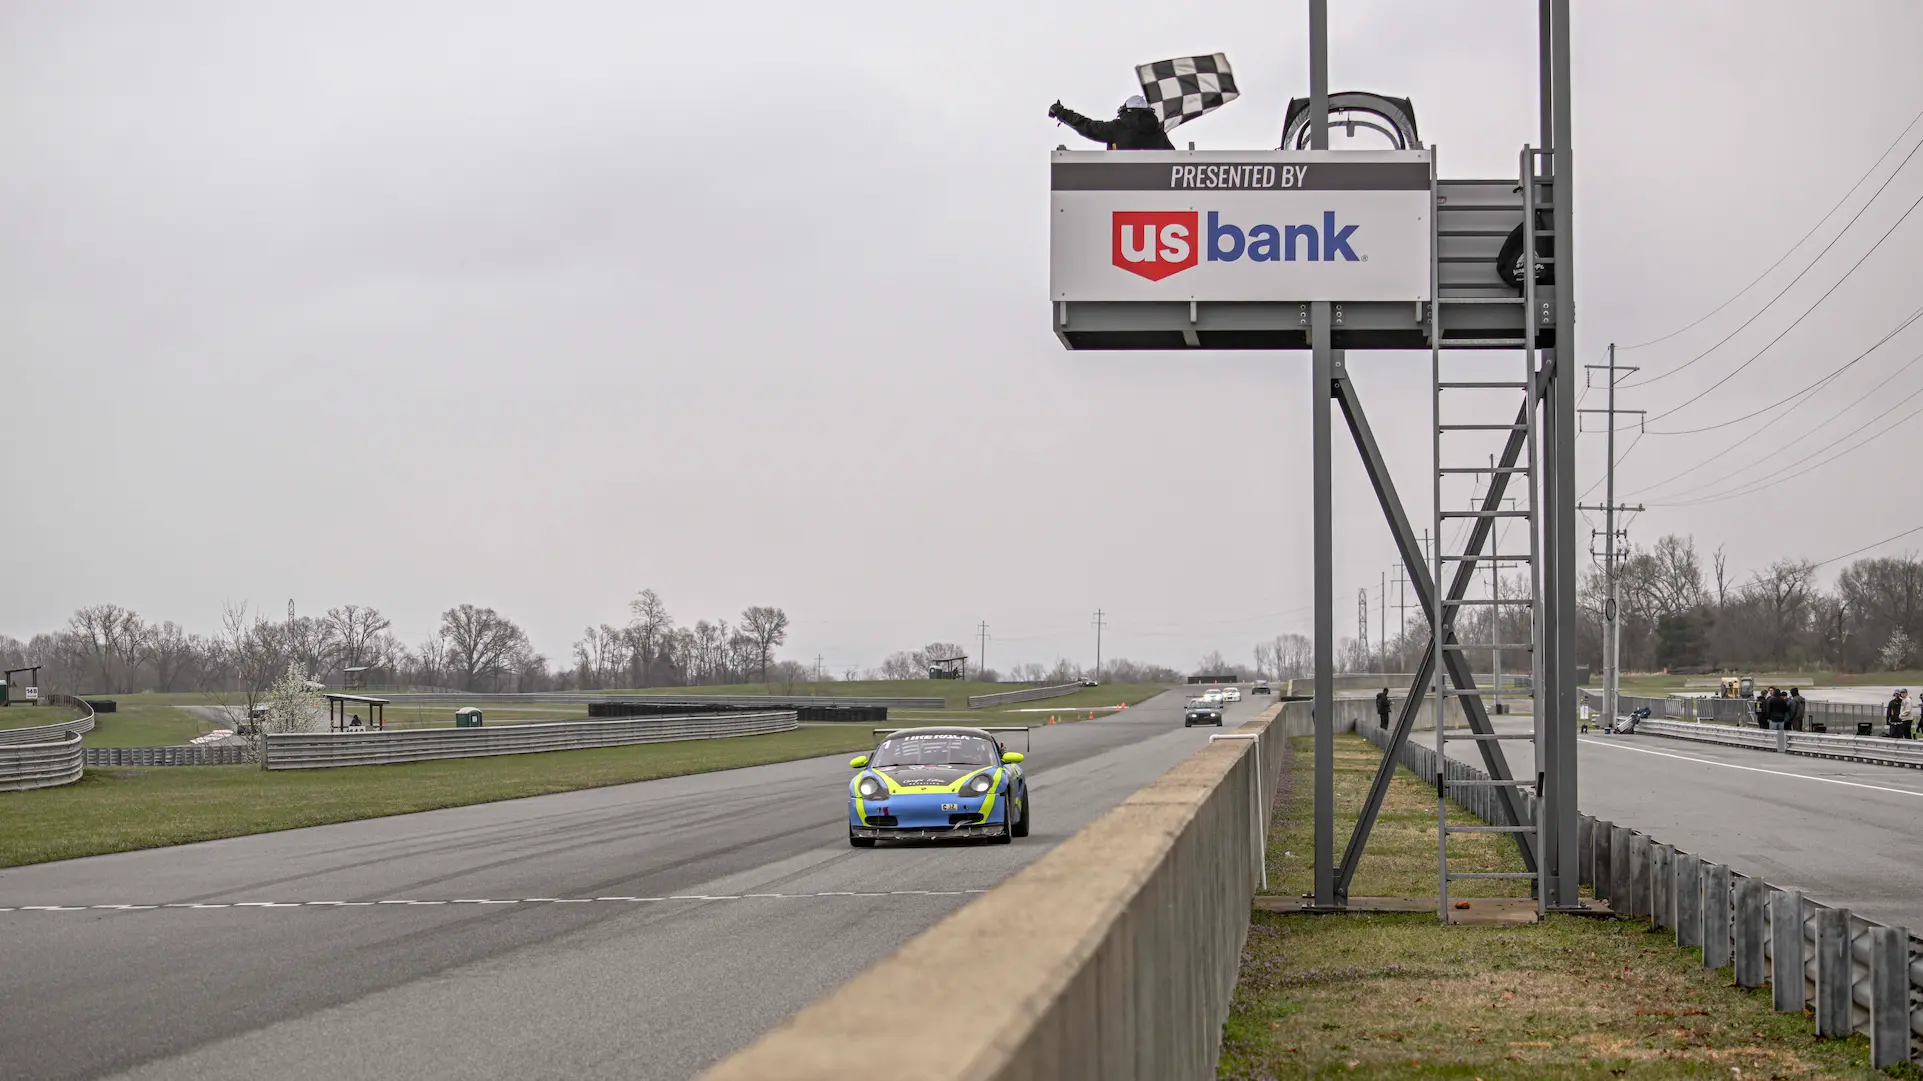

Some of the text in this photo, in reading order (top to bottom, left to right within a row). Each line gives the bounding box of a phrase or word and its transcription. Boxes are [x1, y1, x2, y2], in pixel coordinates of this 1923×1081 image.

[1170, 165, 1308, 188] PRESENTED BY
[1120, 211, 1361, 264] us bank
